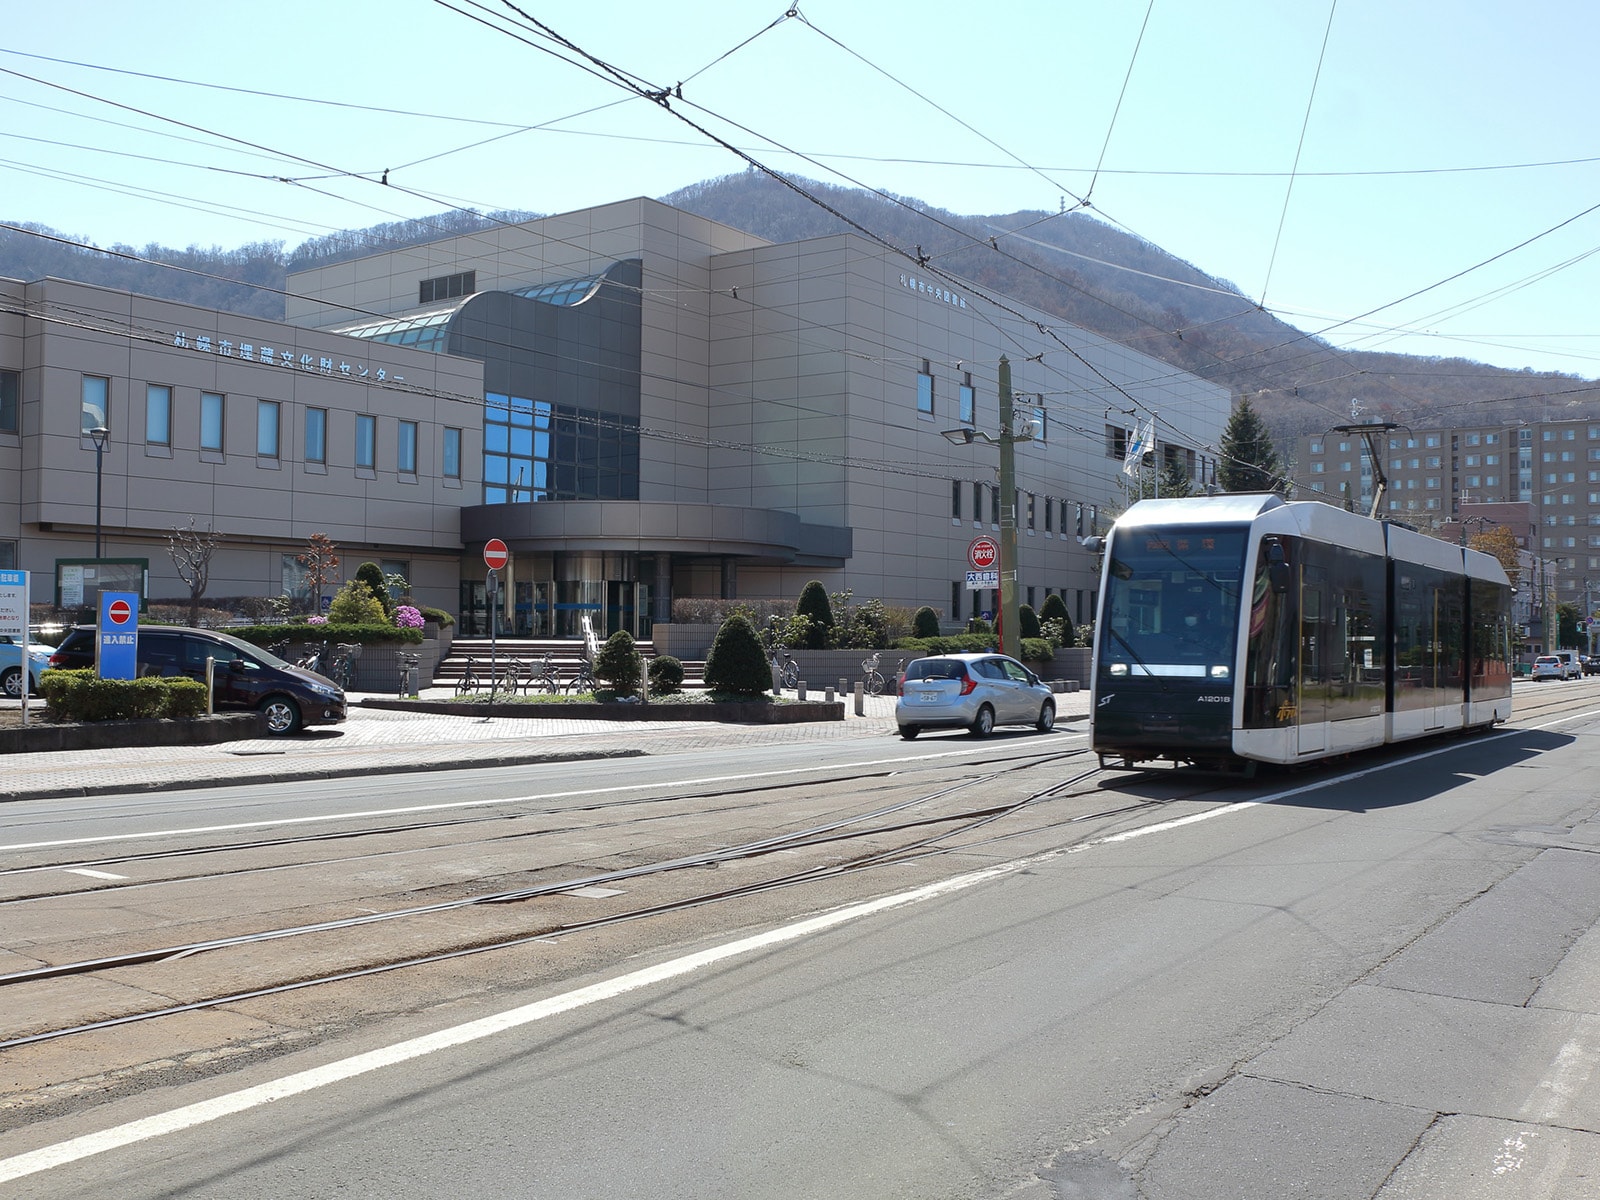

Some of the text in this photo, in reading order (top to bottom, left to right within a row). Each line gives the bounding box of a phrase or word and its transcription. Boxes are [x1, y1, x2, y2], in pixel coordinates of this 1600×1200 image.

[173, 331, 404, 381] 札幌市埋蔵文化財センター
[103, 635, 134, 645] 進入禁止
